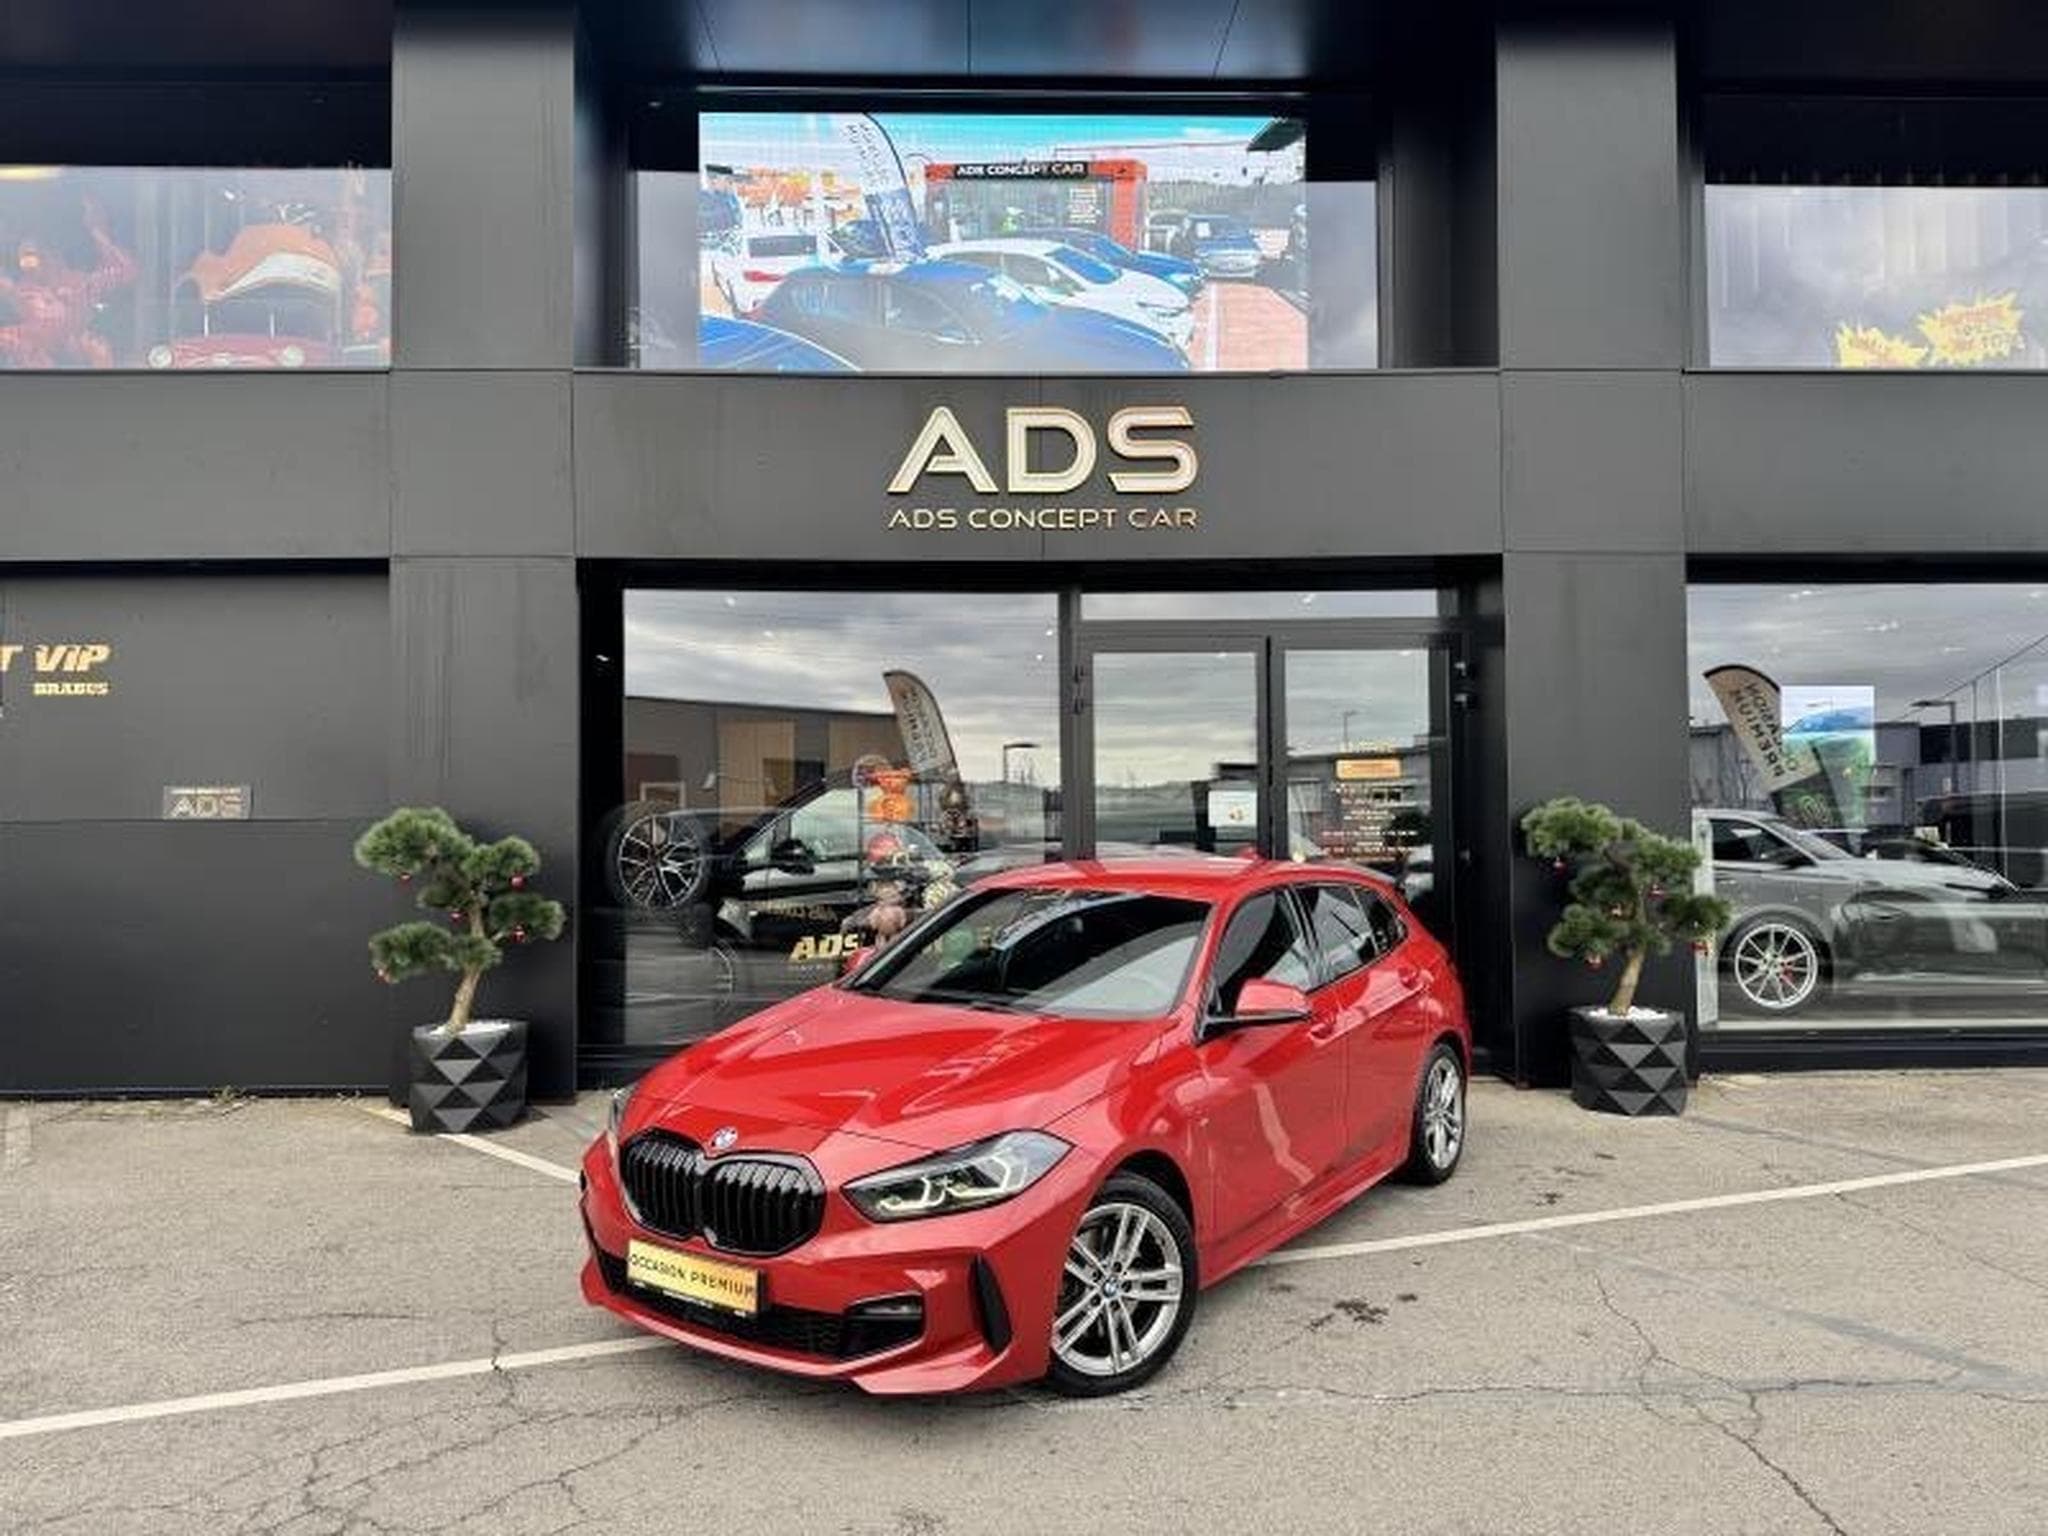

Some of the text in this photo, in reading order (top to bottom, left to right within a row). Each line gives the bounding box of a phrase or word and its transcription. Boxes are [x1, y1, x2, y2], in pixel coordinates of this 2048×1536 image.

[887, 406, 1198, 493] ADS
[888, 508, 1198, 530] ADS CONCEPT CAR
[34, 644, 111, 672] VIP
[788, 933, 859, 963] ADS
[628, 1253, 686, 1279] OCCASION
